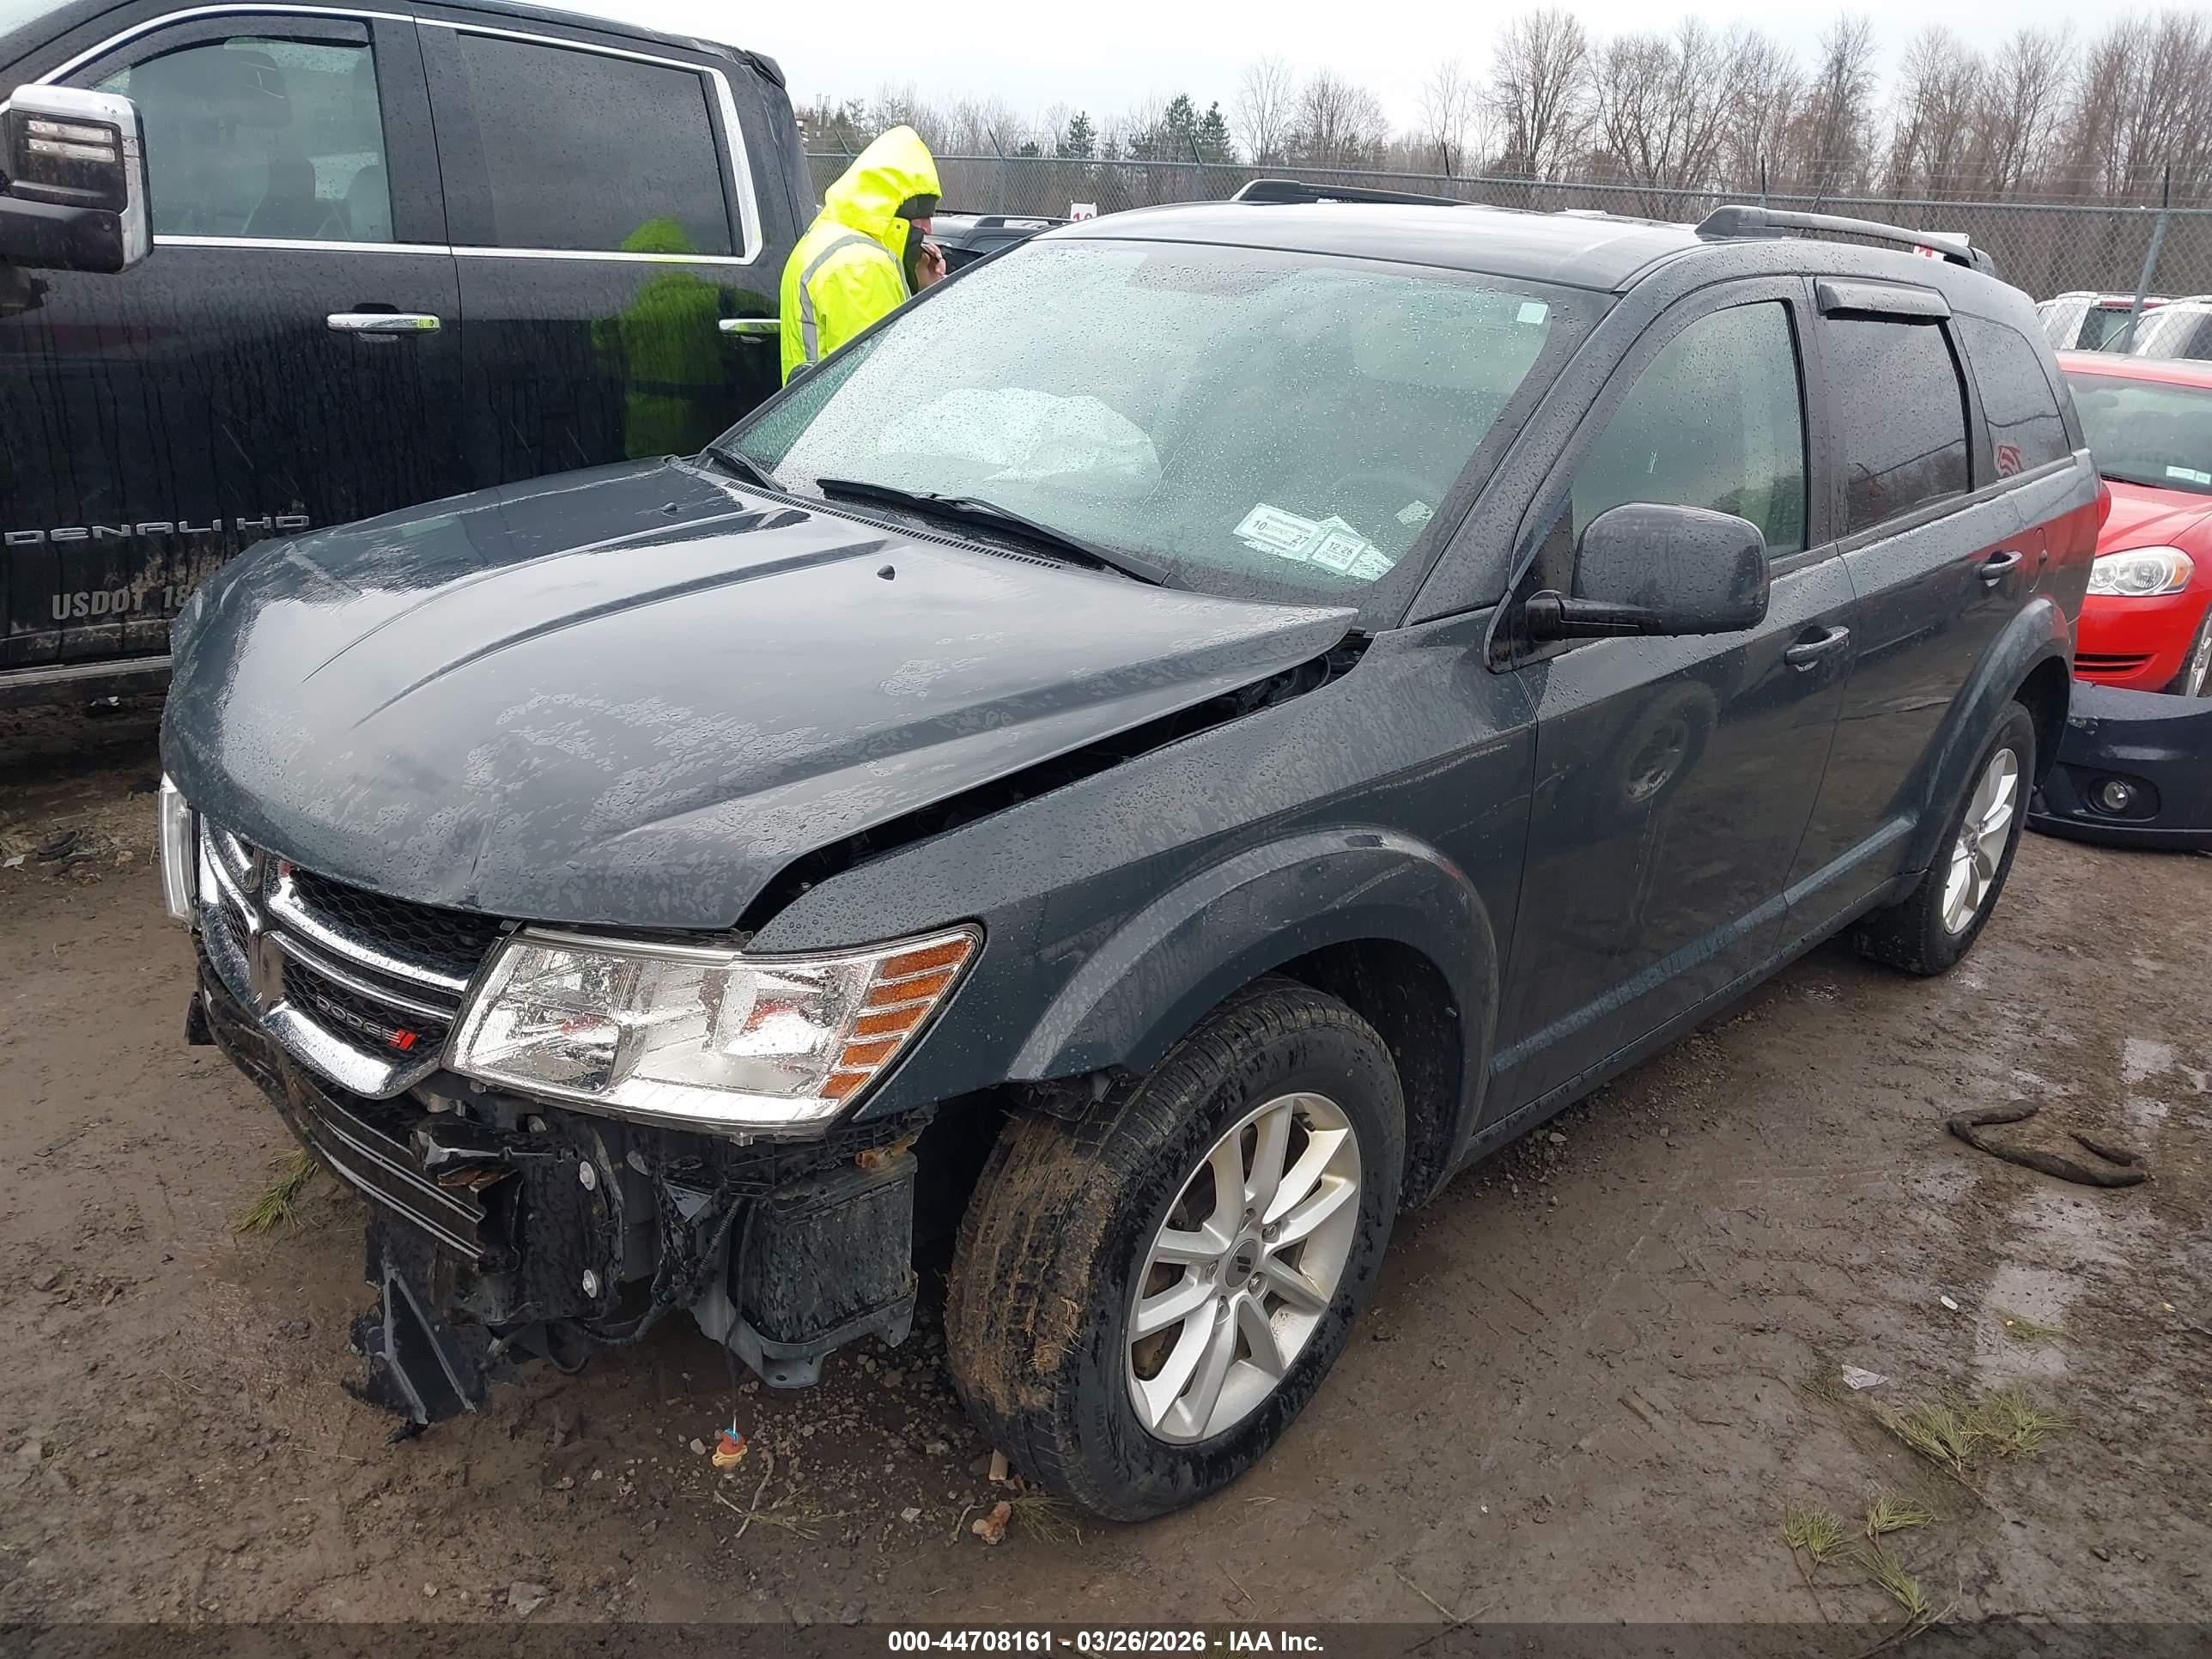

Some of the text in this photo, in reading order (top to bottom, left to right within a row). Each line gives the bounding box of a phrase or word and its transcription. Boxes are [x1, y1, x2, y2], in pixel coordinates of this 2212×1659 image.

[3, 514, 310, 546] DENALI HD
[1252, 520, 1267, 531] 10
[1291, 534, 1310, 545] 27
[52, 587, 148, 620] USDOT
[316, 995, 401, 1044] DODGE
